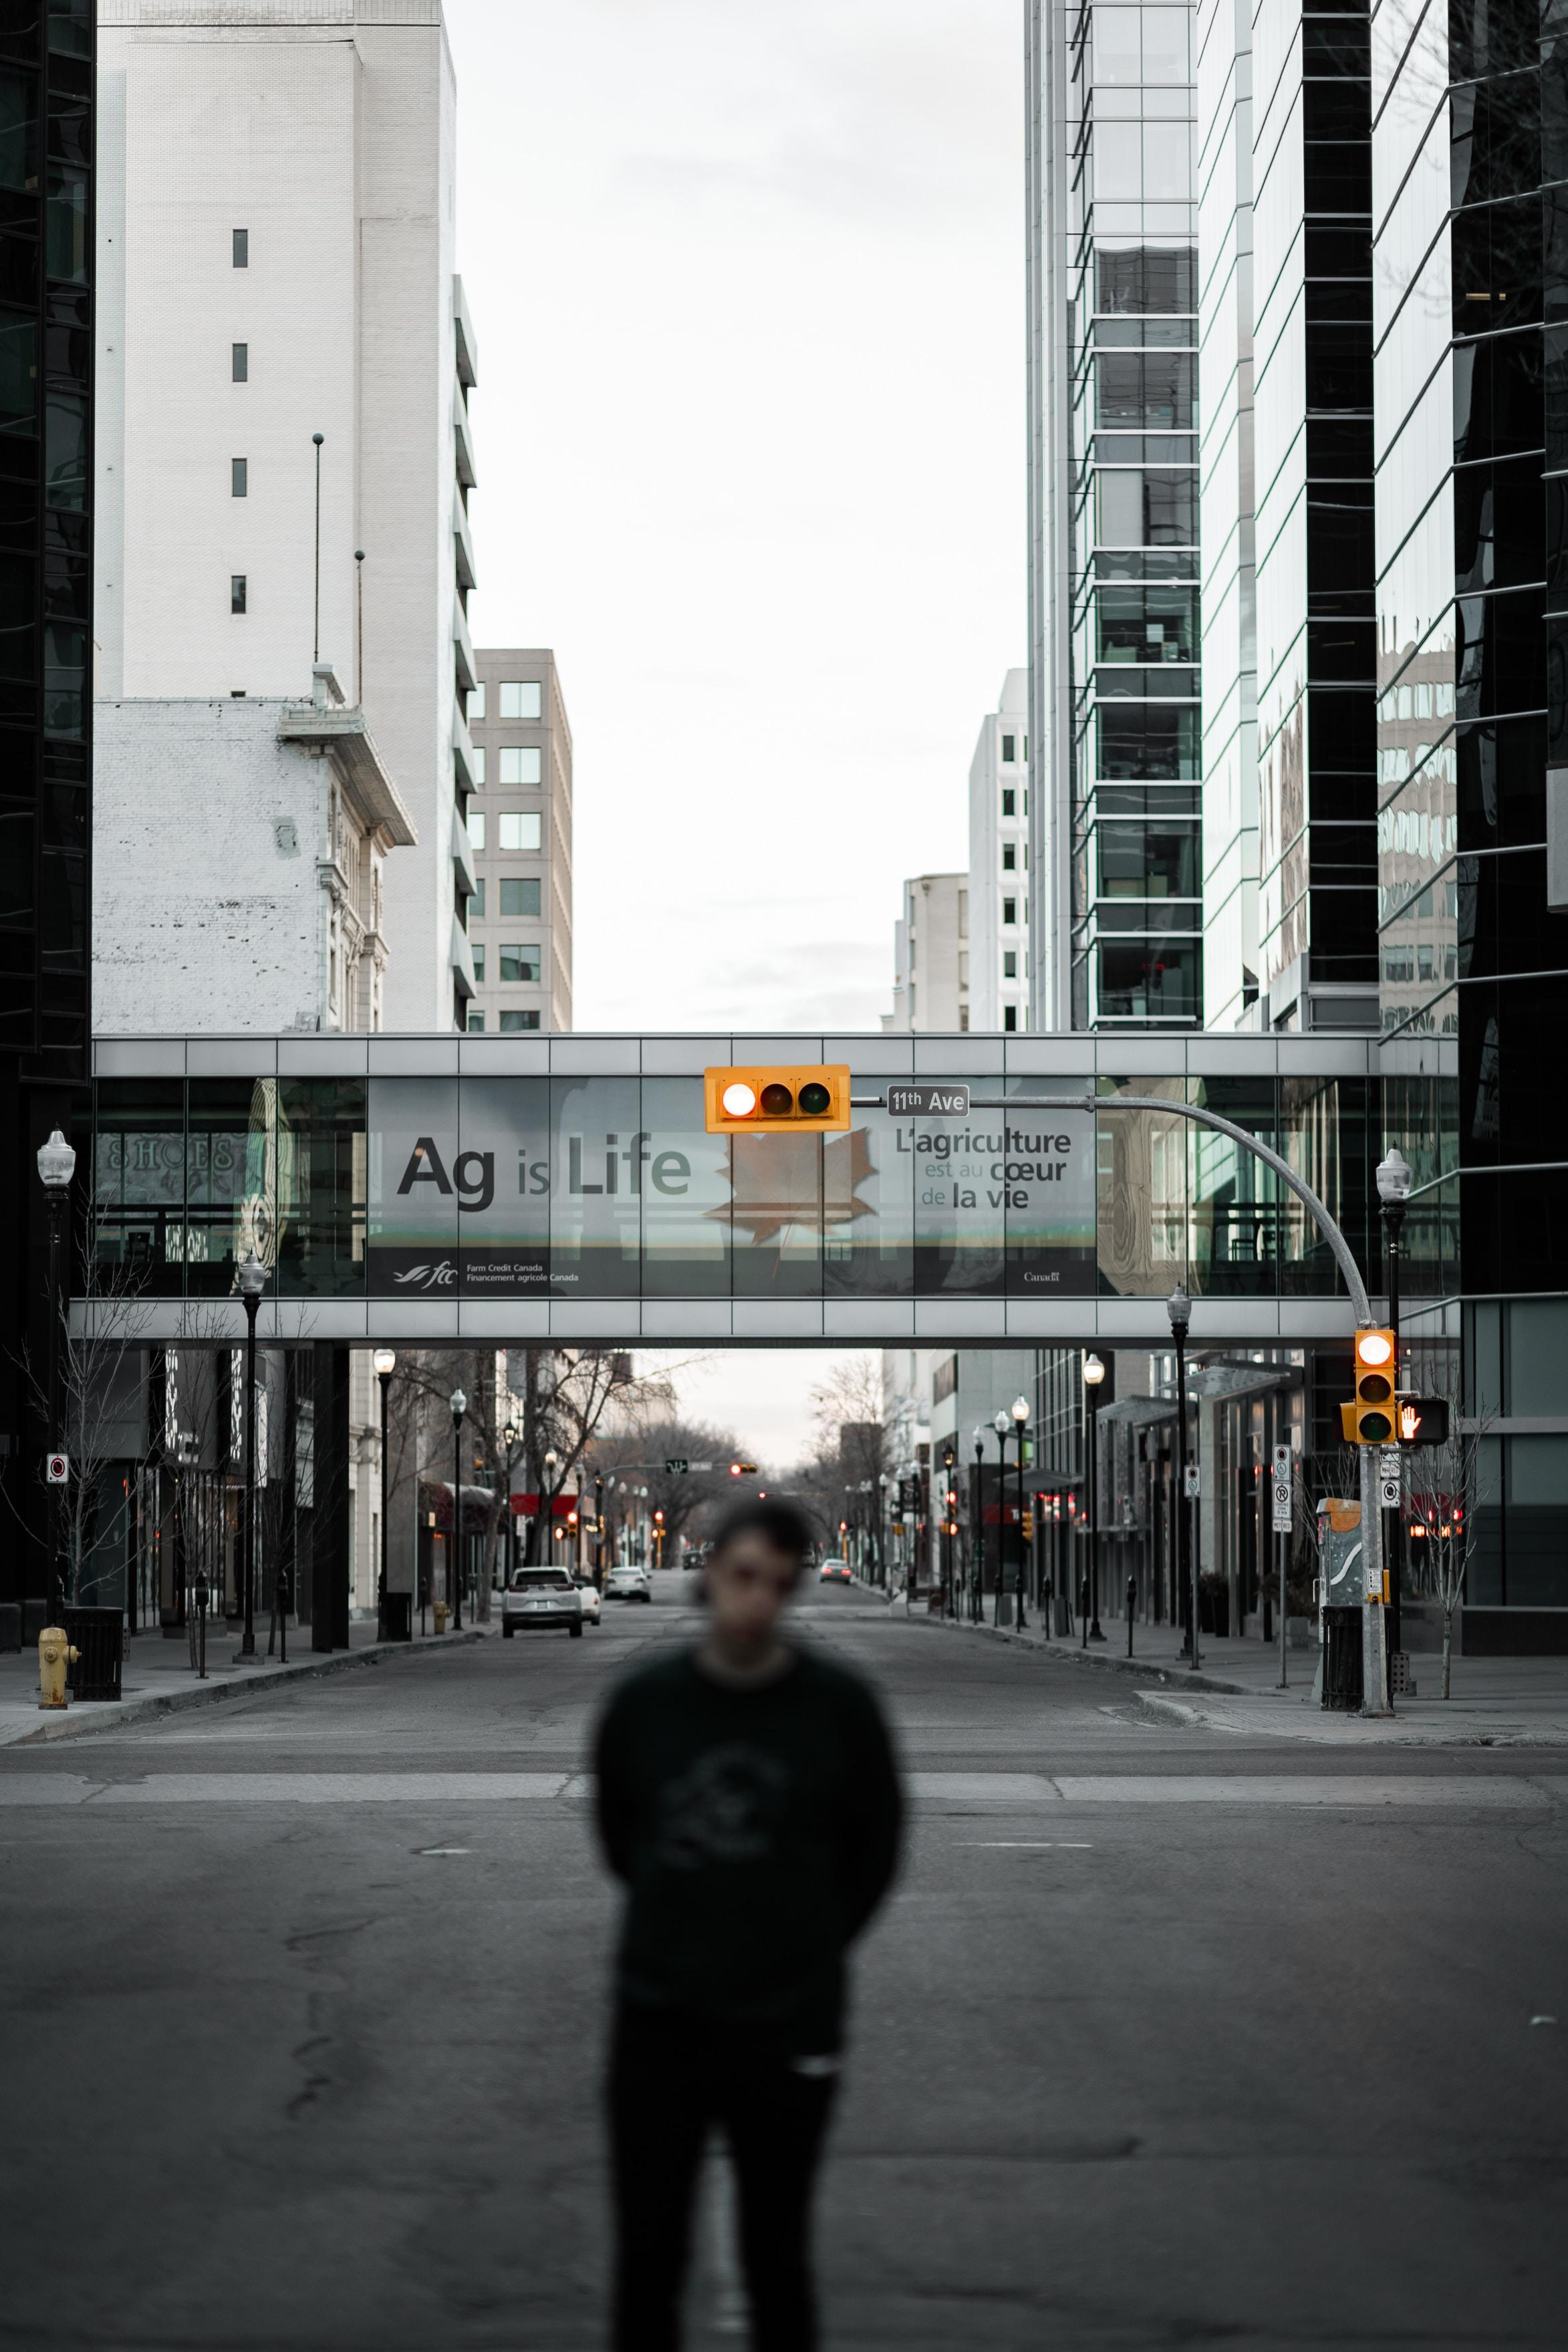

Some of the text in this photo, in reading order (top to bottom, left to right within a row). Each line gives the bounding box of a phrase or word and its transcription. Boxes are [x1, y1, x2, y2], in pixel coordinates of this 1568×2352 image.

[893, 1092, 964, 1110] 11th Ave
[896, 1127, 1071, 1160] L'agriculture
[108, 1139, 233, 1170] SHOES
[396, 1132, 691, 1212] Ag is Life
[925, 1162, 1067, 1181] est au cœur
[922, 1182, 1029, 1208] de la vie
[488, 1264, 511, 1272] Credit
[513, 1264, 543, 1272] Canada
[1024, 1271, 1059, 1282] Canada
[517, 1273, 547, 1283] agricole
[549, 1273, 579, 1281] Canada
